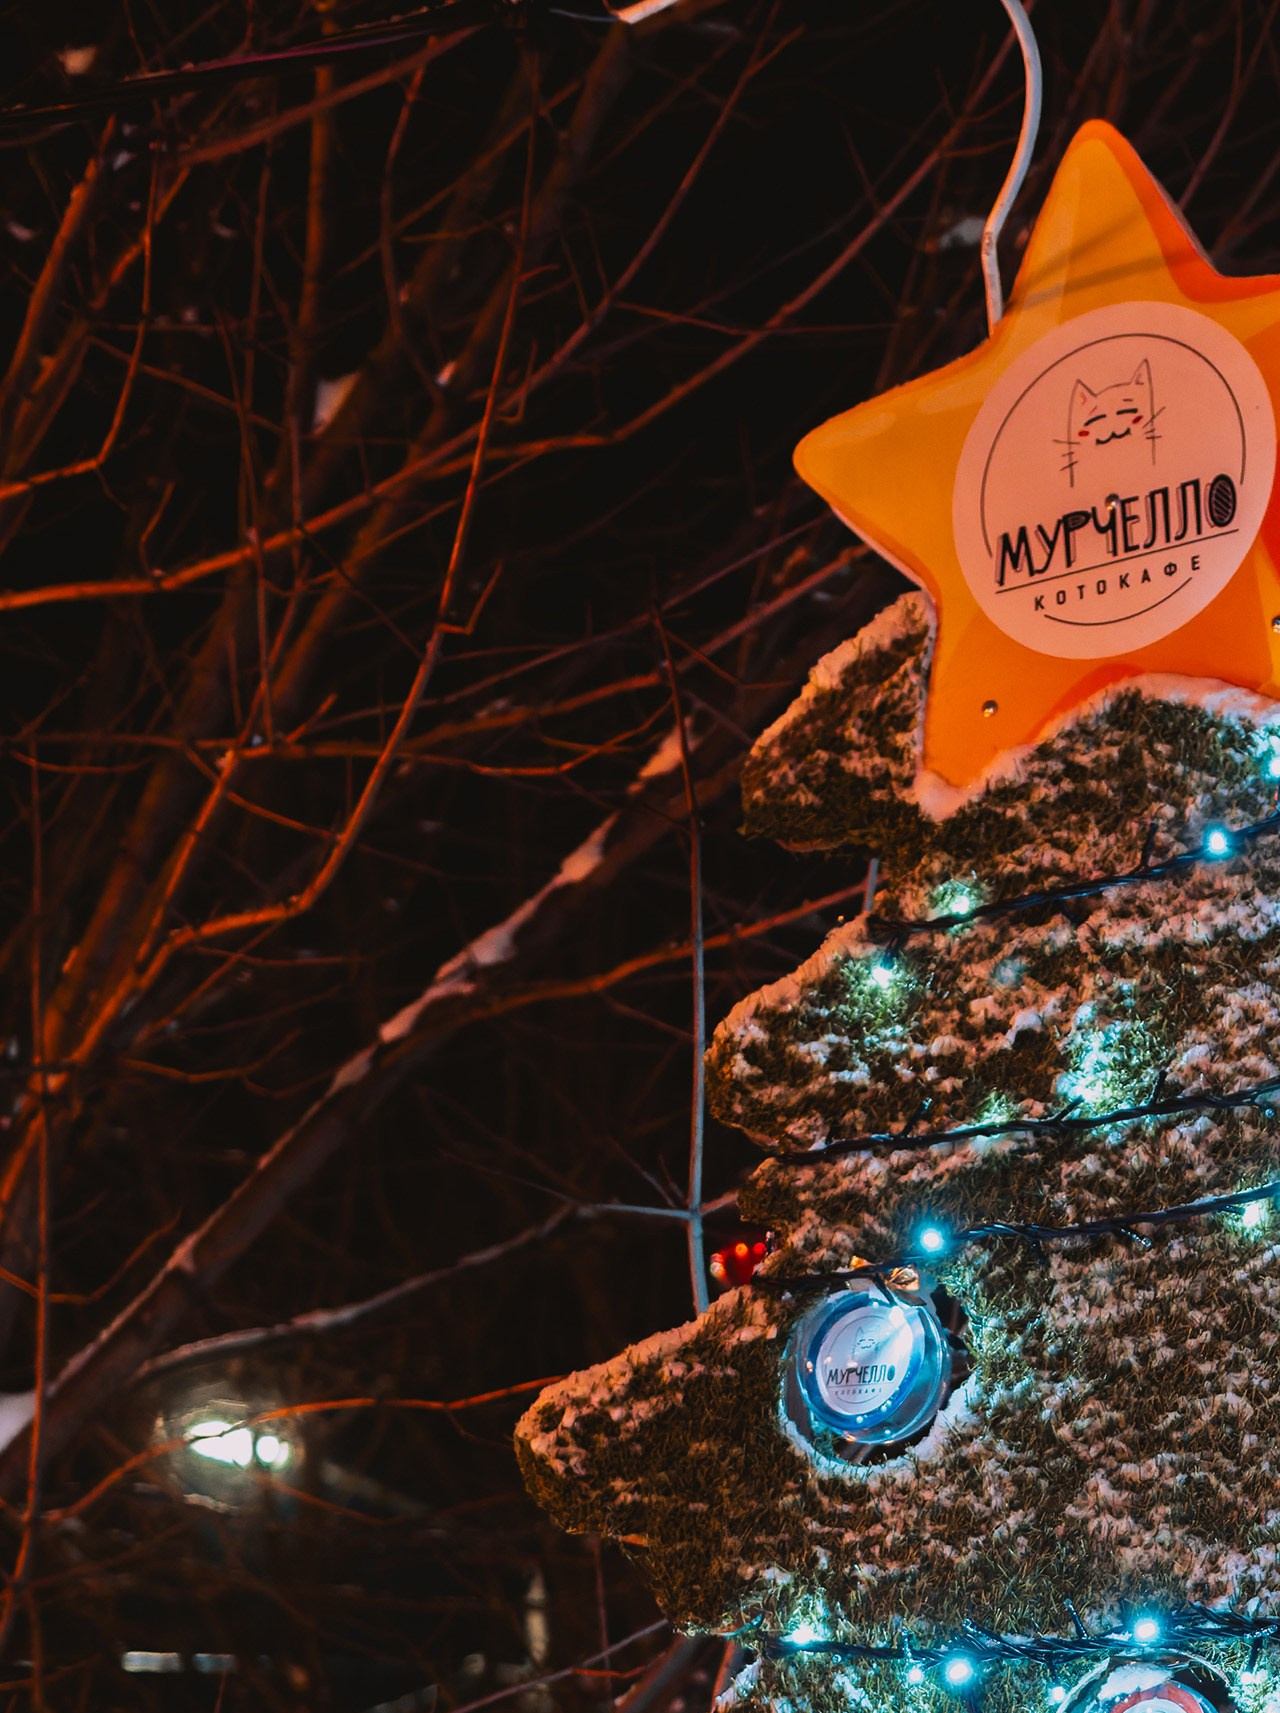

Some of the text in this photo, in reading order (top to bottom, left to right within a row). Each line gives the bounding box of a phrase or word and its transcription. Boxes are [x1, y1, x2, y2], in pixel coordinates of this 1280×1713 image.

[995, 473, 1236, 587] МУРЧЕЛЛО
[1034, 555, 1201, 611] КОТОКАФЕ
[826, 1363, 896, 1386] МУРЧЕЛЛО
